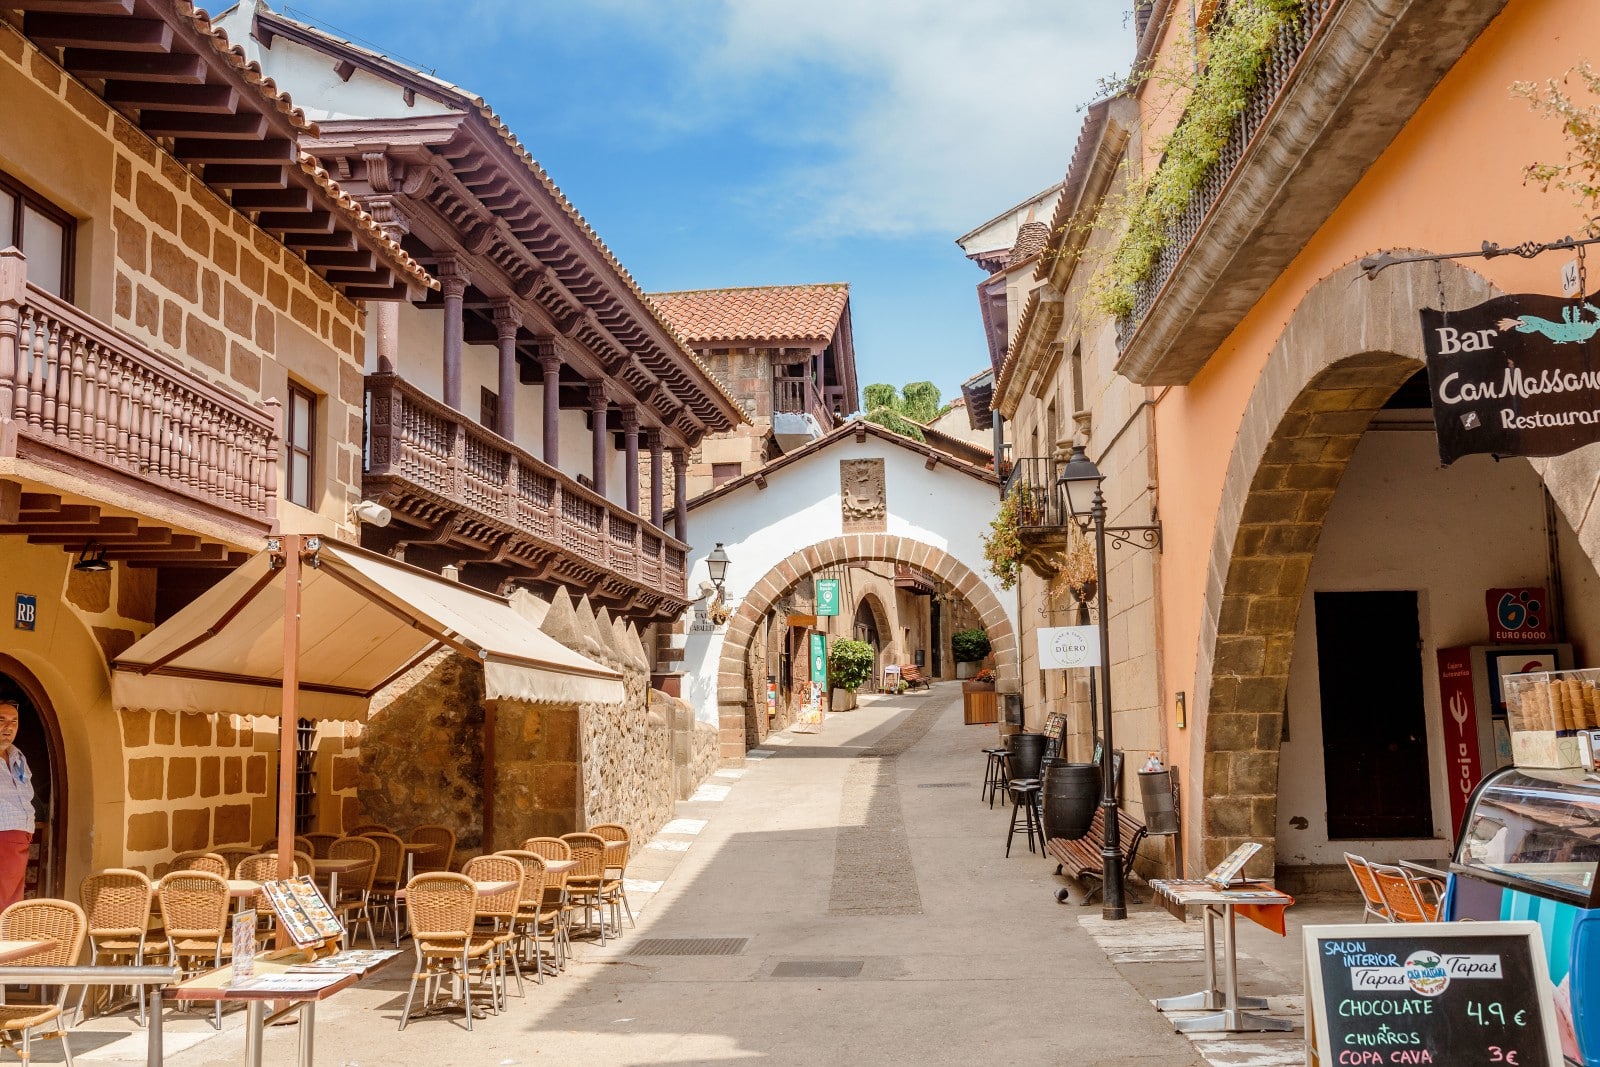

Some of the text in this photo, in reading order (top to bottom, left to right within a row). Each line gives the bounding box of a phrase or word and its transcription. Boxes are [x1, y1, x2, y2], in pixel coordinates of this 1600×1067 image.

[1435, 327, 1498, 355] Bar
[1439, 371, 1498, 404] Can
[17, 603, 35, 622] RB
[1496, 631, 1546, 639] EURO 6000
[1324, 941, 1366, 955] SALON
[1447, 955, 1497, 977] Tapas
[1355, 969, 1405, 990] Tapas
[1338, 999, 1527, 1026] CHOCOLATE 4.9 €
[1344, 1032, 1421, 1045] CHURROS
[1339, 1050, 1384, 1065] COPA
[1390, 1049, 1433, 1064] CAVA
